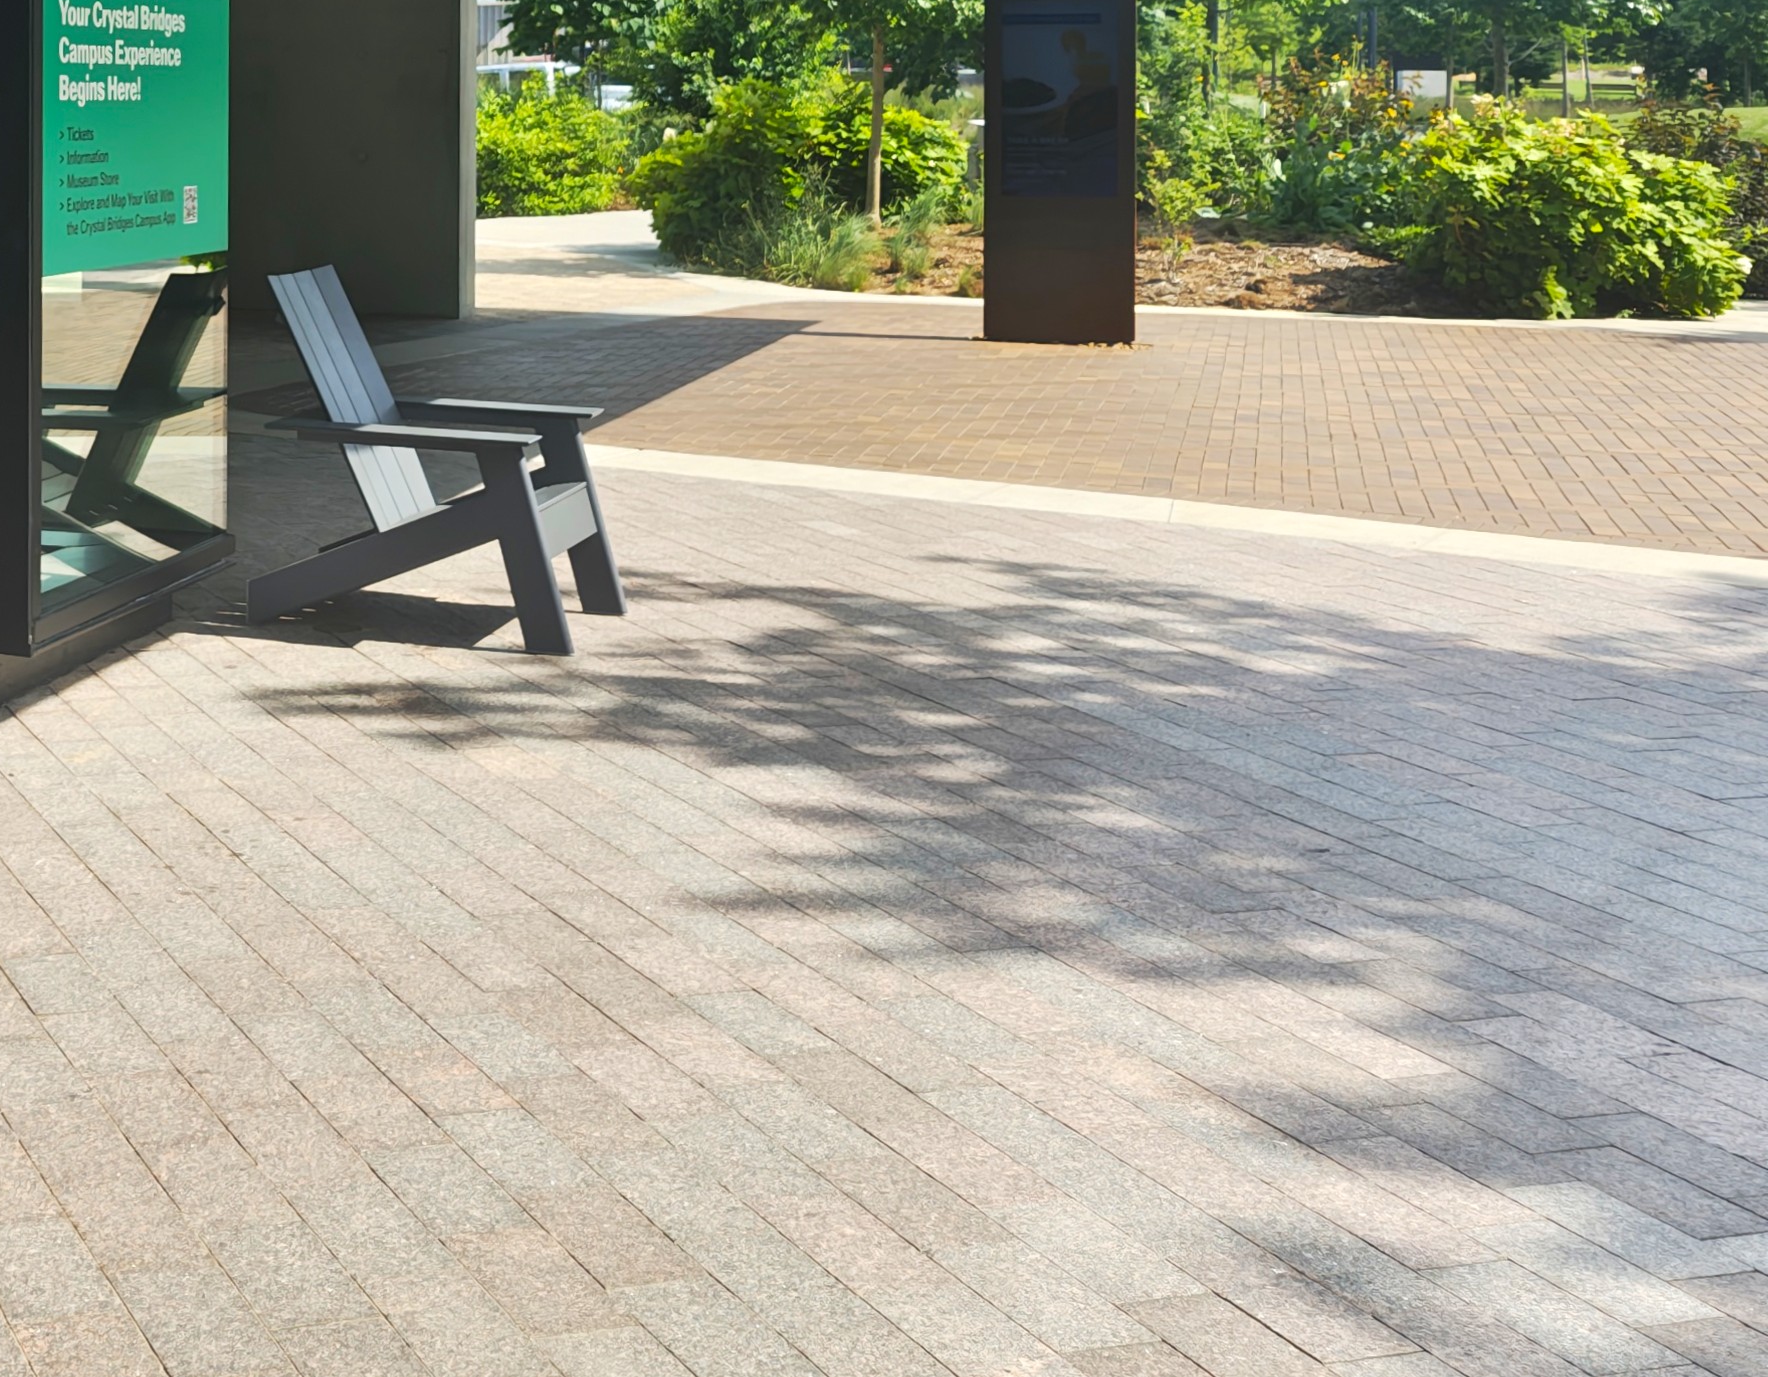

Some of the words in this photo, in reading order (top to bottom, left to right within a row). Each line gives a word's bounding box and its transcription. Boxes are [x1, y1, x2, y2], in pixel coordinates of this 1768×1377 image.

[59, 0, 90, 26] Your
[93, 2, 138, 33] Crystal
[141, 6, 185, 37] Bridges
[59, 37, 113, 69] Campus
[115, 40, 181, 70] Experience
[59, 74, 105, 107] Begins
[108, 76, 141, 101] Here!
[67, 127, 94, 141] Tickets
[67, 150, 109, 164] Information
[67, 174, 99, 188] Museum
[100, 172, 119, 186] Store
[67, 197, 94, 213] Explore
[97, 196, 109, 209] and
[111, 194, 126, 209] Map
[127, 193, 143, 206] Your
[144, 190, 158, 204] Visit
[67, 221, 79, 236] the
[80, 219, 105, 236] Crystal
[107, 216, 134, 232] Bridges
[135, 213, 162, 228] Campus
[163, 211, 176, 225] App
